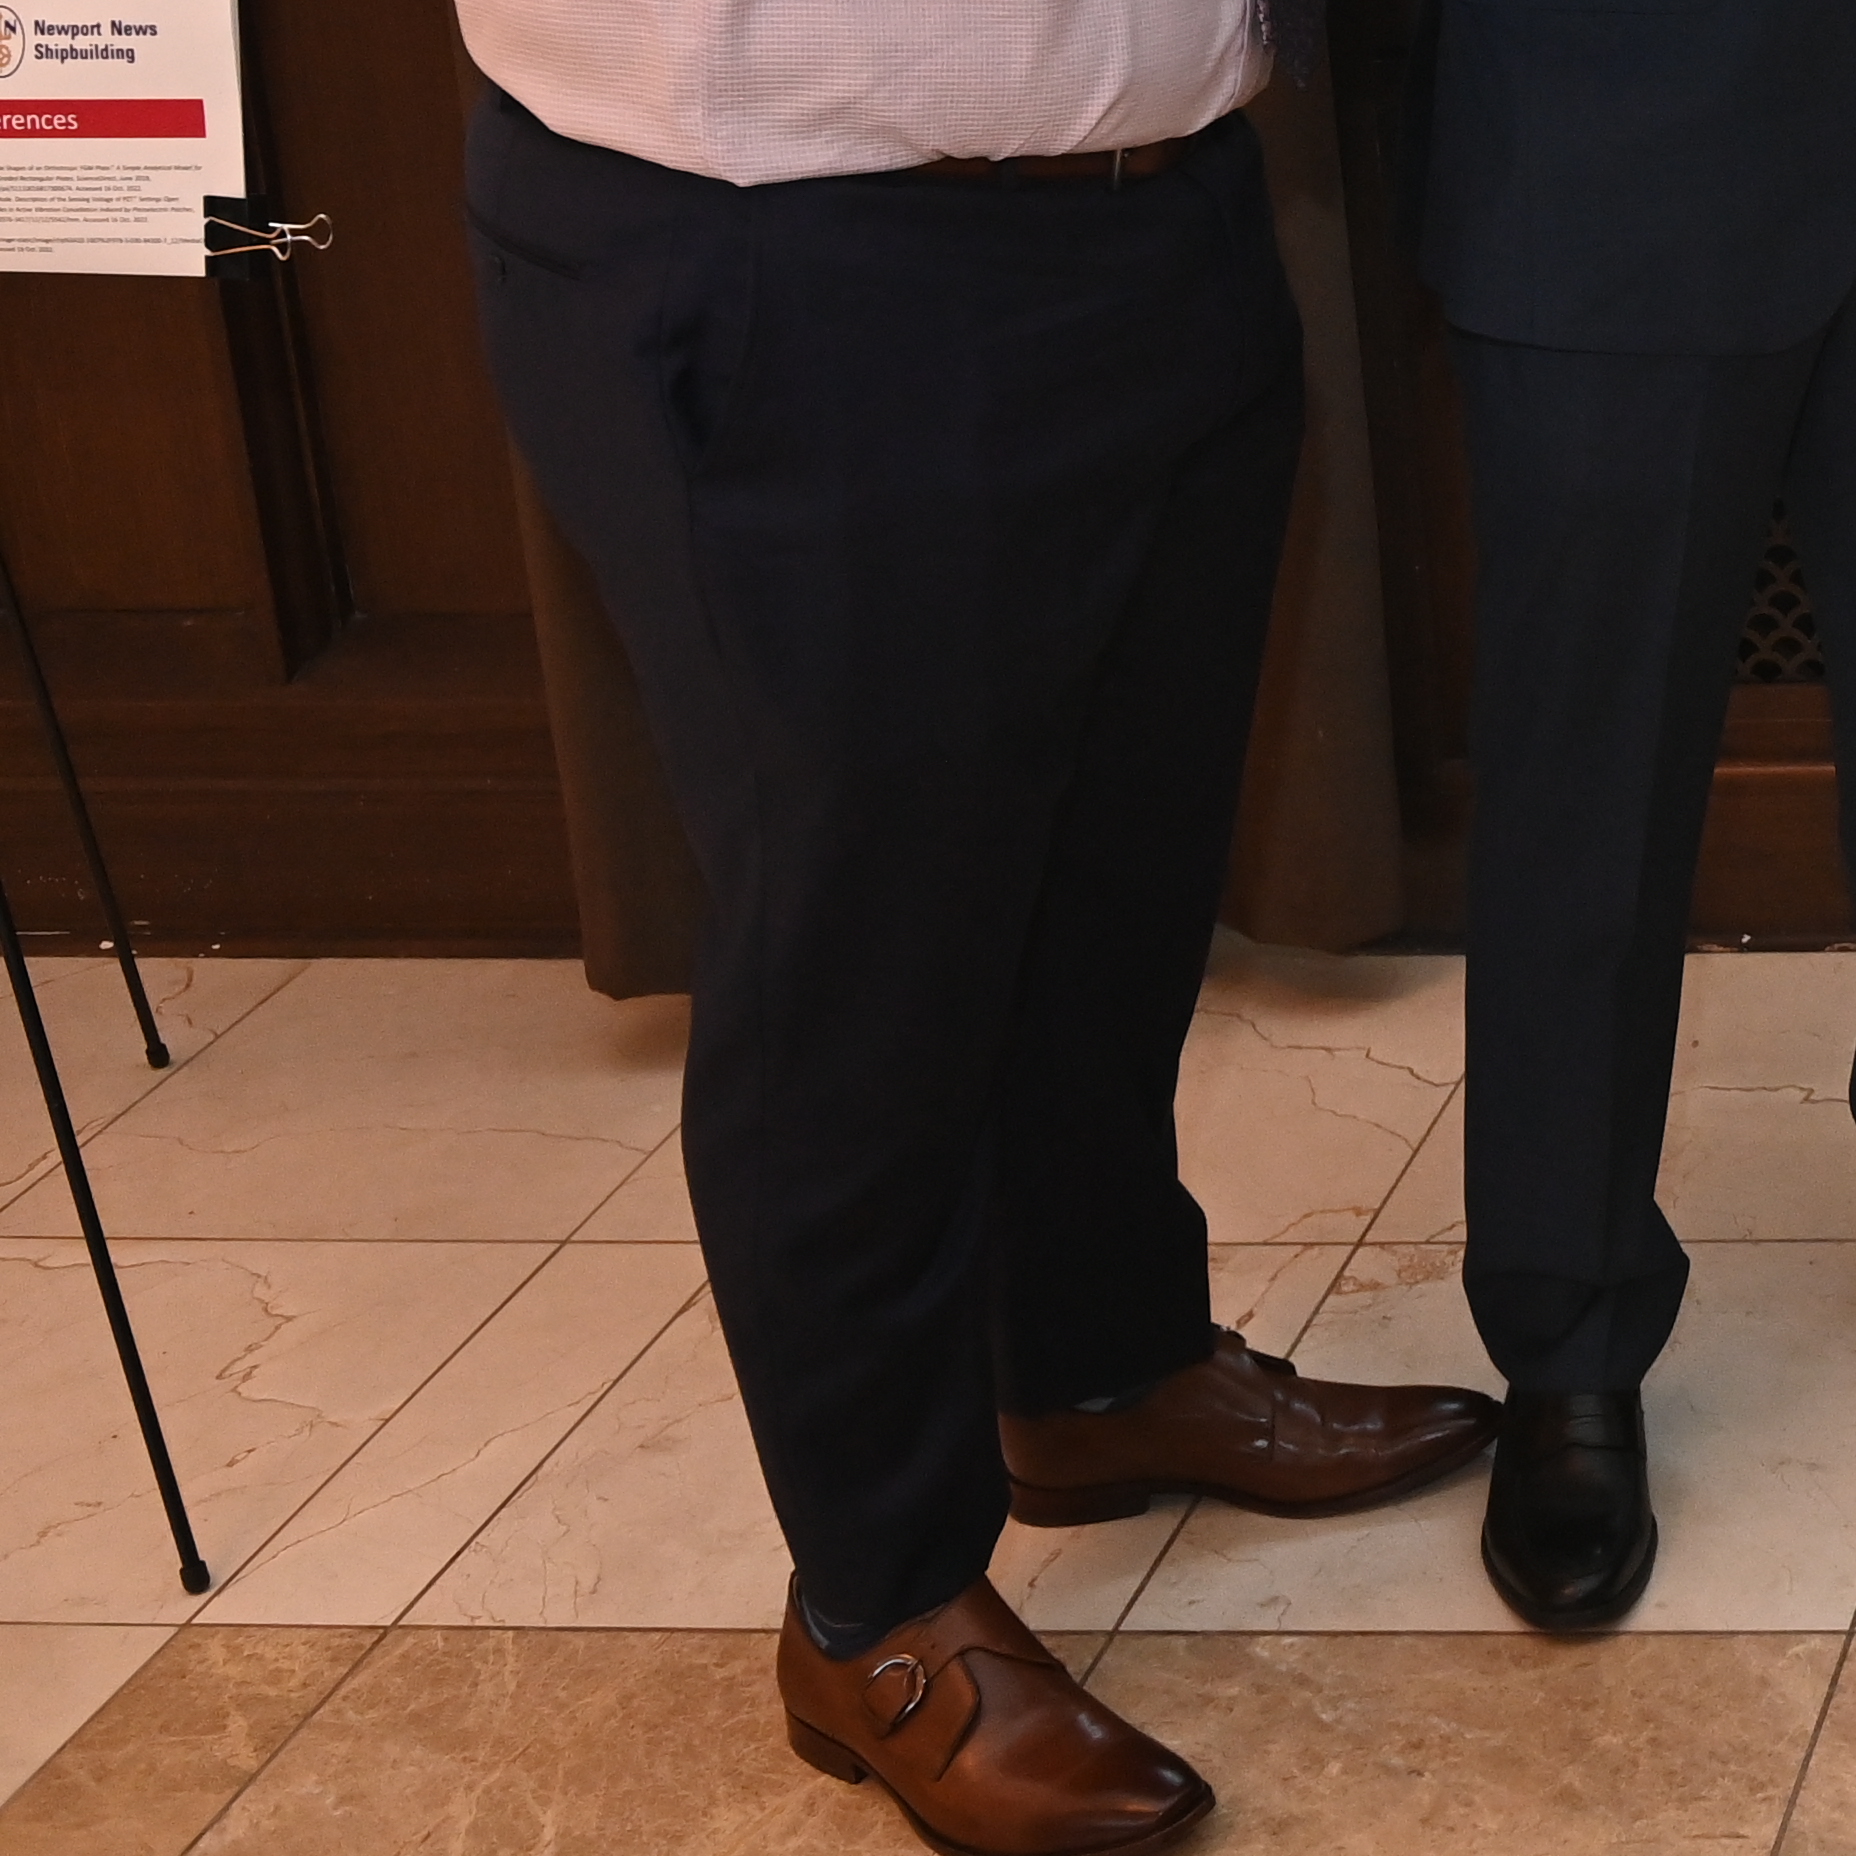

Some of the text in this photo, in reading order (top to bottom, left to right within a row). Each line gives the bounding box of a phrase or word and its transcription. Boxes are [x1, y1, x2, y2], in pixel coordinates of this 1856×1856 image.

[34, 20, 158, 40] Newport News
[34, 43, 136, 64] Shipbuilding
